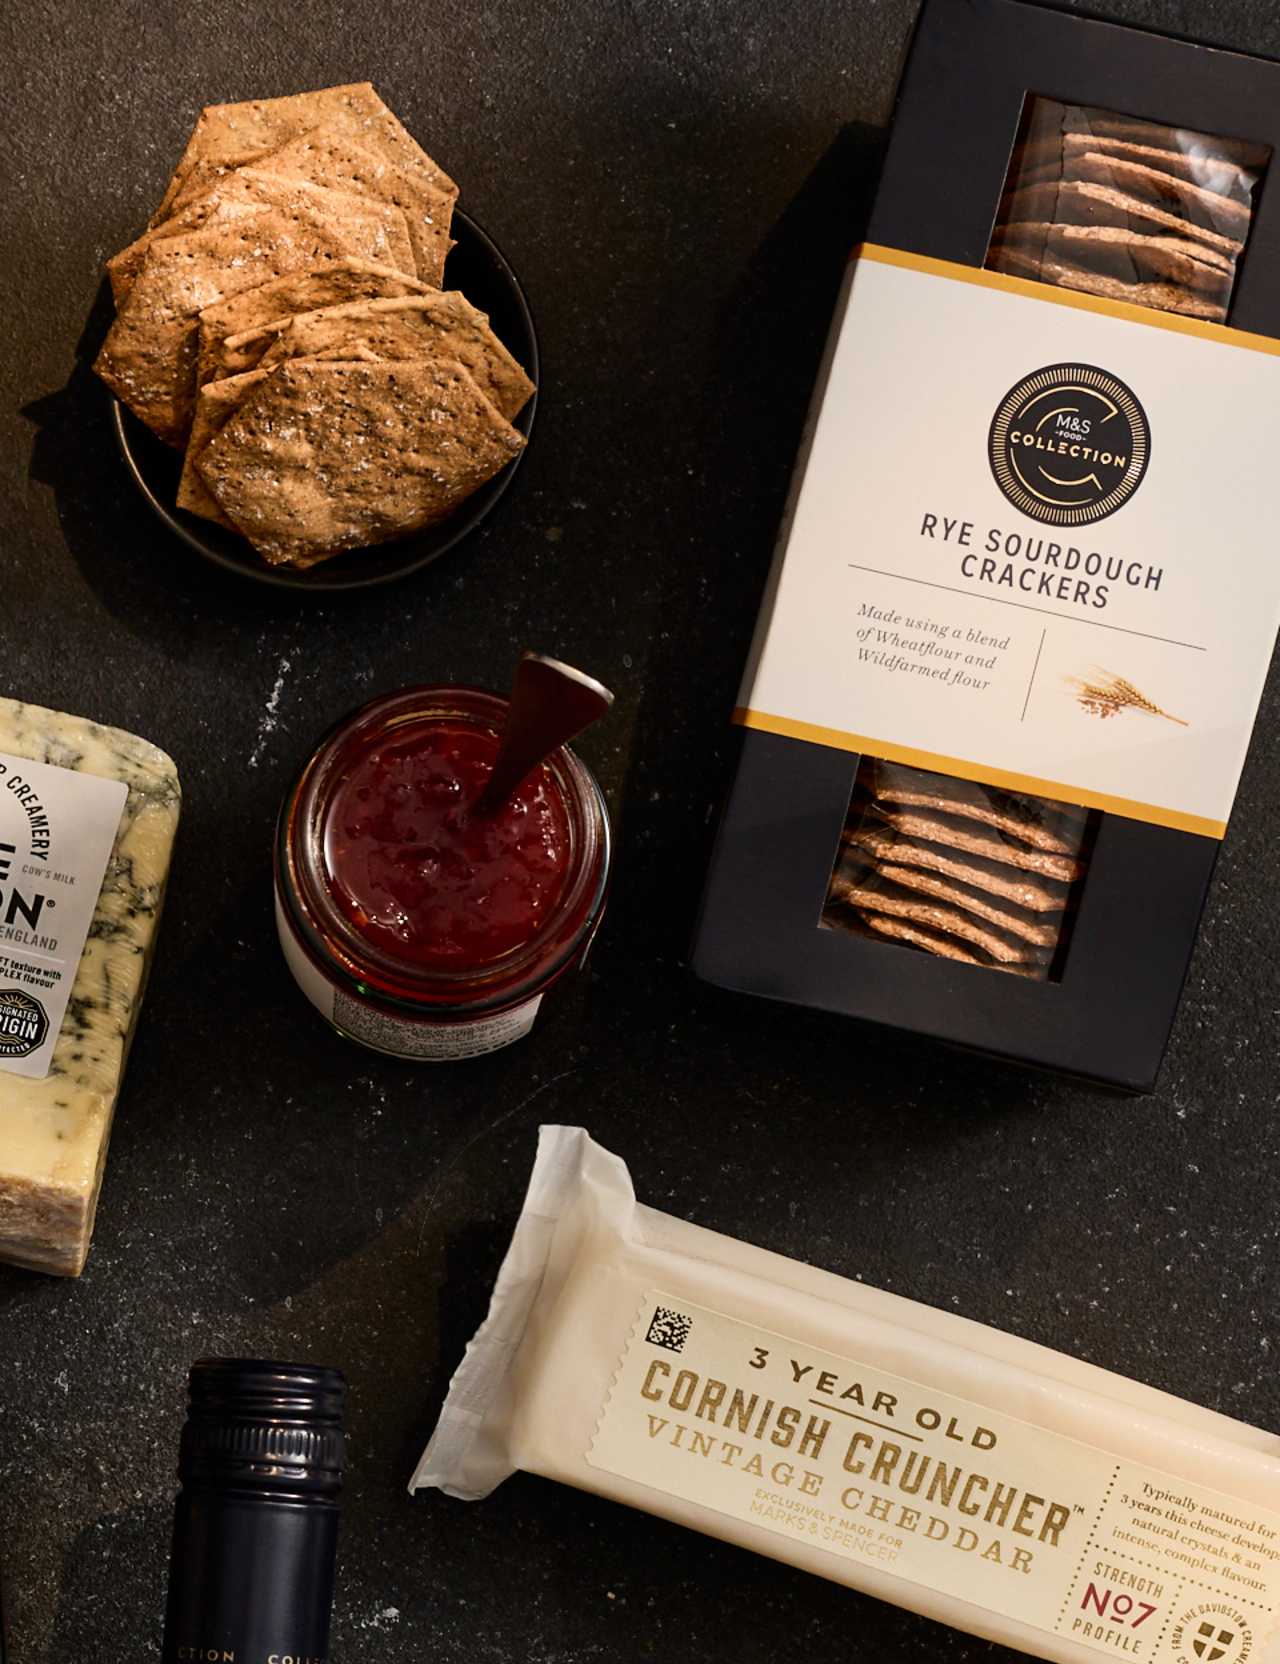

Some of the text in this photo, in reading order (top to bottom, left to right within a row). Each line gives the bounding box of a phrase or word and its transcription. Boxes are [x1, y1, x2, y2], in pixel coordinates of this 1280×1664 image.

[1011, 431, 1126, 468] COLLECTION
[1056, 415, 1091, 434] M&S
[921, 513, 1163, 591] RYE SOURDOUGH
[960, 554, 1110, 610] CRACKERS
[856, 627, 997, 669] of Wheatflour and
[857, 603, 1010, 650] Made using a blend
[858, 648, 990, 690] Wildfarmed flour
[6, 776, 50, 861] CREAMERY
[640, 1360, 831, 1460] CORNISH
[749, 1347, 997, 1450] 3 YEAR OLD
[647, 1414, 1034, 1574] VINTAGE CHEDDAR
[1120, 1494, 1129, 1504] 3
[1128, 1499, 1162, 1516] years
[1165, 1510, 1188, 1525] this
[1190, 1520, 1230, 1540] cheese
[1142, 1482, 1277, 1539] Typically matured for
[1112, 1526, 1267, 1592] intense, complex flavour.
[1132, 1517, 1261, 1571] natural crystals & an
[1094, 1562, 1164, 1598] STRENGTH
[1072, 1618, 1143, 1654] PROFILE
